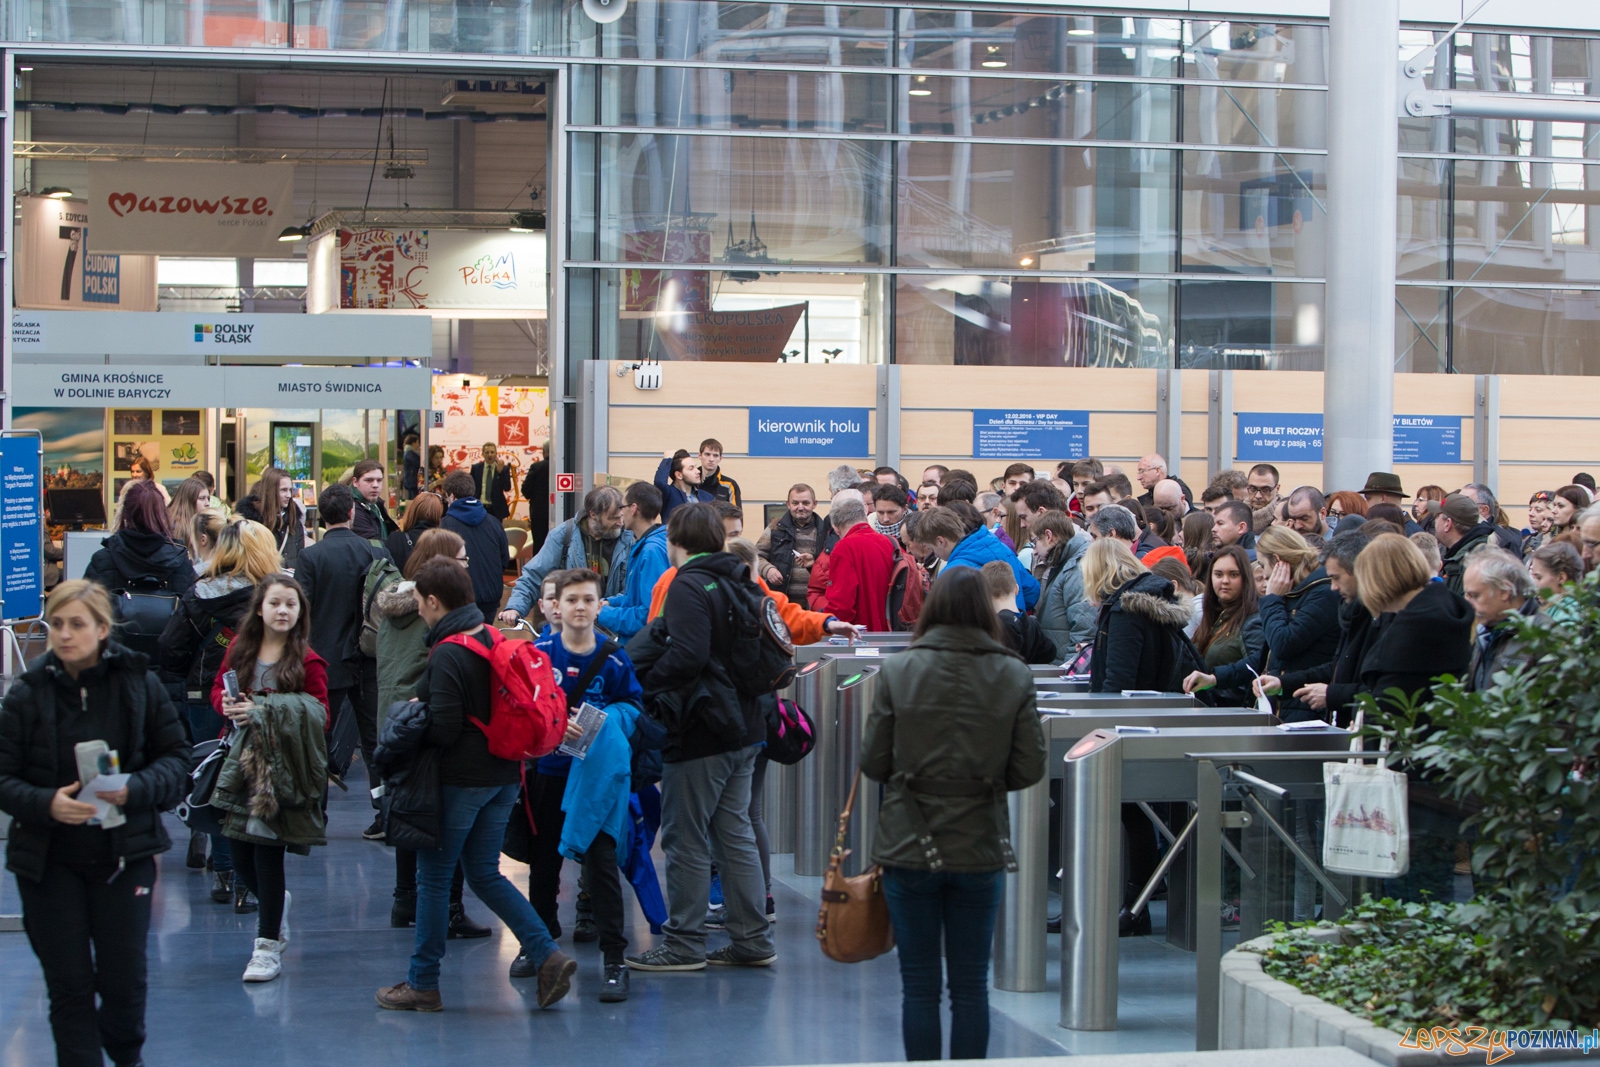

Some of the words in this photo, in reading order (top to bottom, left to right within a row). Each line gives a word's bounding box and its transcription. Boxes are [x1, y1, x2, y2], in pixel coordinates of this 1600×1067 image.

[108, 192, 273, 217] Mazowsze.
[242, 218, 268, 226] Polski
[85, 275, 117, 296] POLSKI
[687, 313, 785, 326] ELKOPOLSKA
[214, 324, 254, 334] DOLNY
[214, 332, 252, 344] ŚLĄSK
[740, 346, 772, 355] ludzie
[61, 374, 100, 384] GMINA
[104, 372, 164, 384] KROŚNICE
[278, 383, 320, 392] MIASTO
[324, 380, 382, 393] ŚWIDNICA
[54, 388, 66, 398] W
[68, 388, 114, 398] DOLINIE
[118, 389, 171, 399] BARYCZY
[435, 412, 442, 422] 51
[1402, 417, 1433, 426] BILETÓW
[758, 419, 826, 432] kierownik
[830, 420, 860, 432] holu
[1287, 427, 1320, 435] ROCZNY
[1264, 439, 1280, 448] targi
[1287, 439, 1306, 448] pasją
